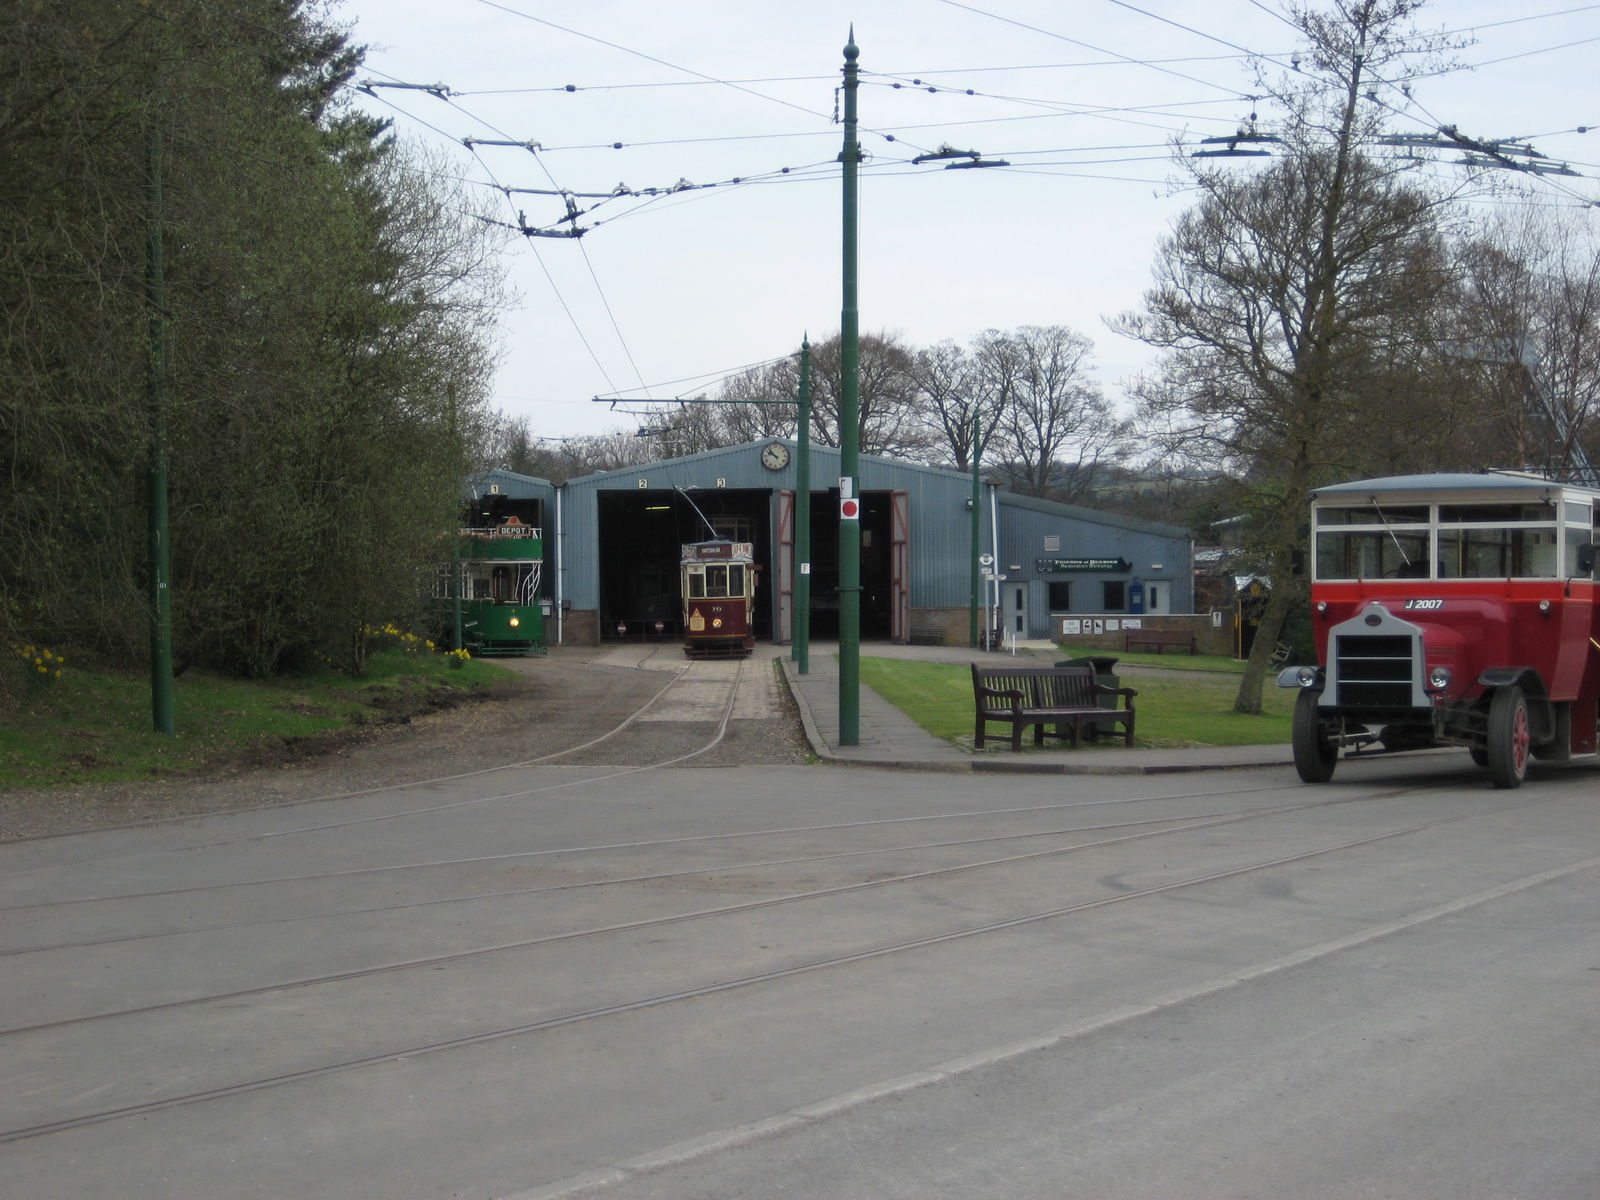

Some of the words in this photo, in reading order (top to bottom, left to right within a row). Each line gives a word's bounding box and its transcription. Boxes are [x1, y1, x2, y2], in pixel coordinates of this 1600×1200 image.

[718, 479, 725, 487] 3
[1405, 600, 1413, 609] J
[1415, 600, 1443, 609] 2007
